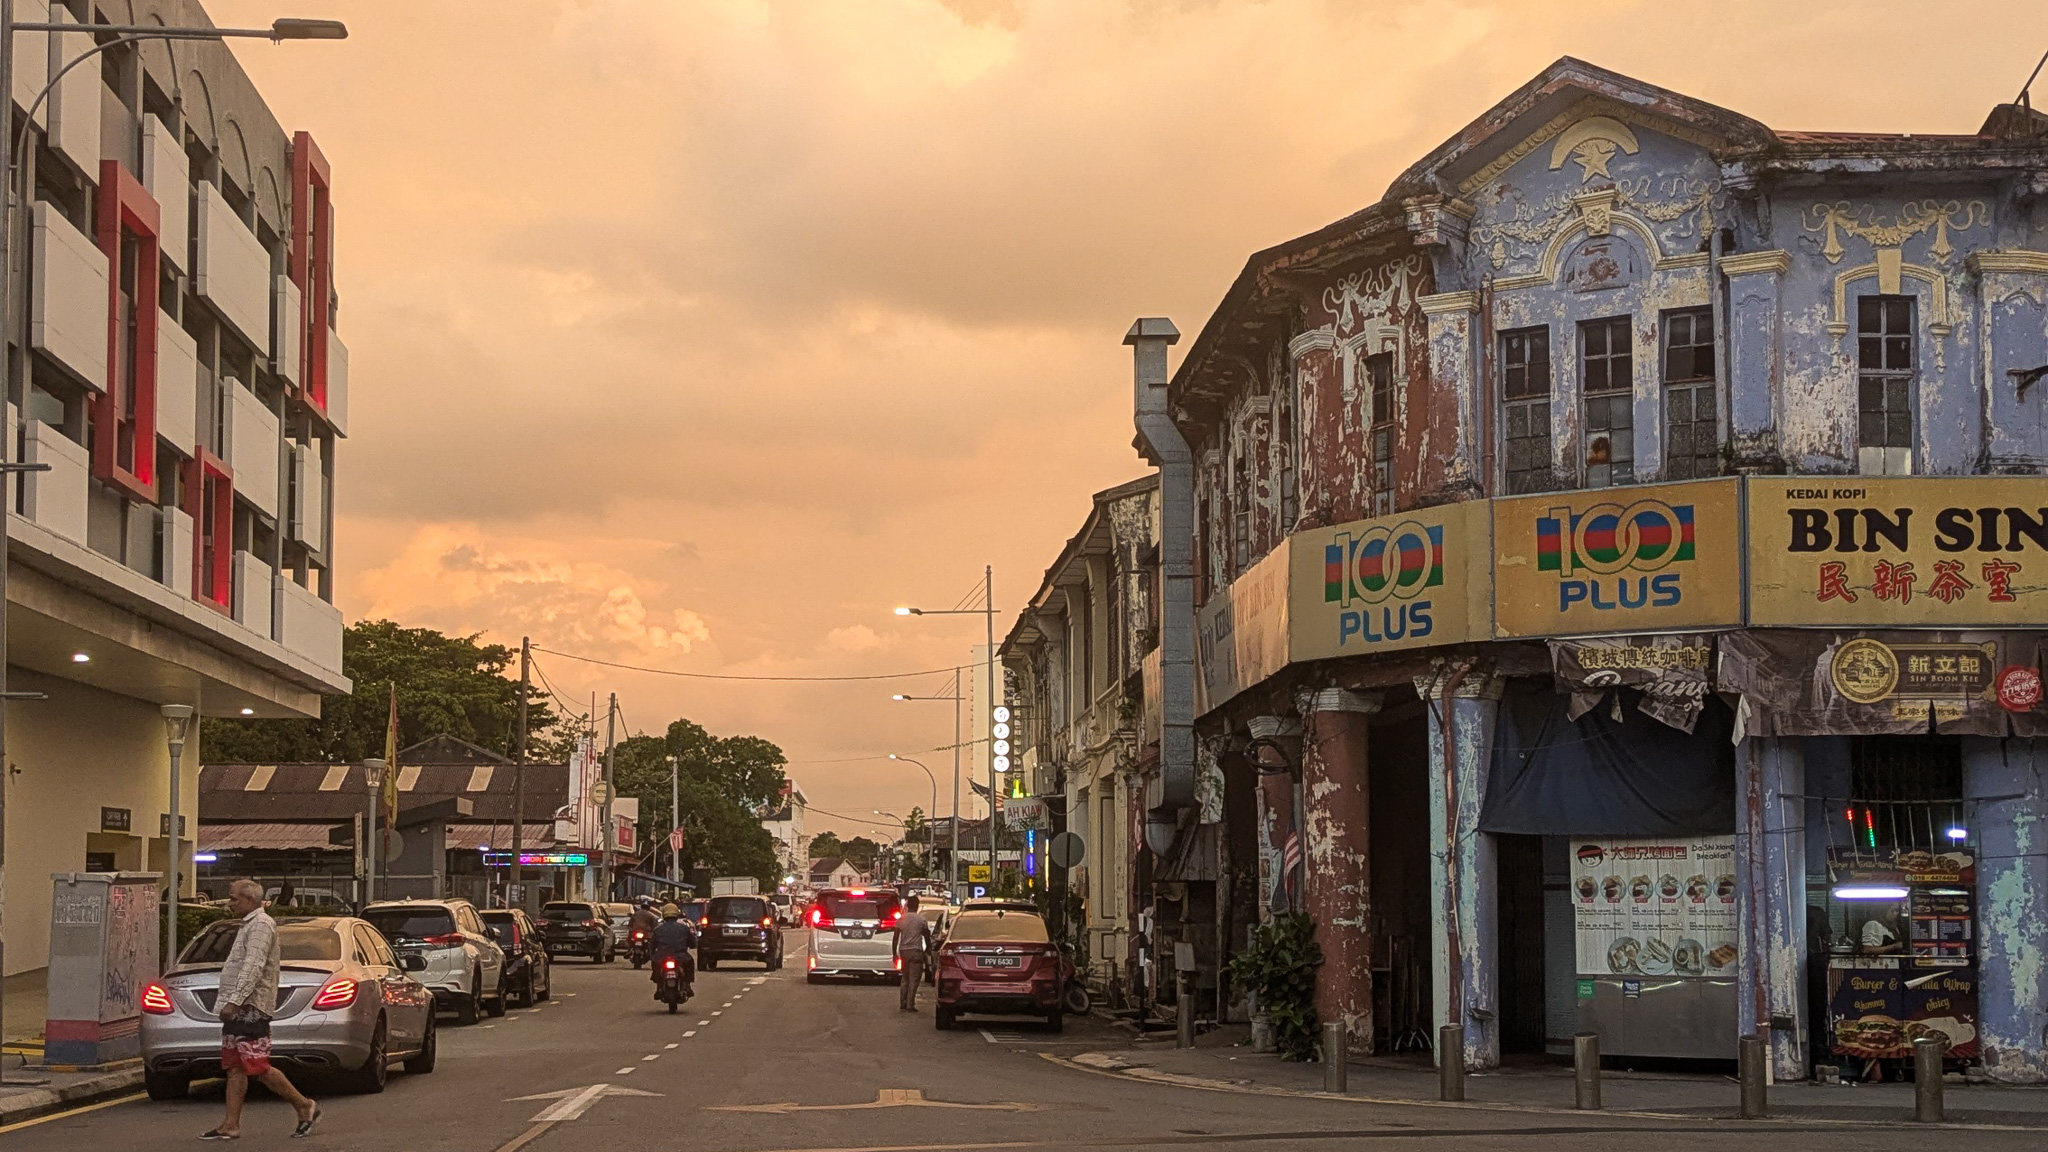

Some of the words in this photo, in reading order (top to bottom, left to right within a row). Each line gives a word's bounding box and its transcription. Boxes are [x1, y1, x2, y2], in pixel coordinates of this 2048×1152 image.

[1786, 489, 1828, 499] KEDAI
[1833, 489, 1867, 499] KOPI
[1549, 499, 1683, 578] 100
[1787, 508, 1913, 553] BIN
[1334, 520, 1433, 608] 100
[1816, 558, 2022, 605] 民新茶室
[1560, 574, 1682, 612] PLUS
[1340, 601, 1433, 646] PLUS
[1908, 655, 1981, 675] 新文記
[1008, 806, 1019, 818] AH
[1851, 977, 1884, 993] Burger
[1888, 977, 1898, 990] &
[1944, 978, 1971, 994] Wrap
